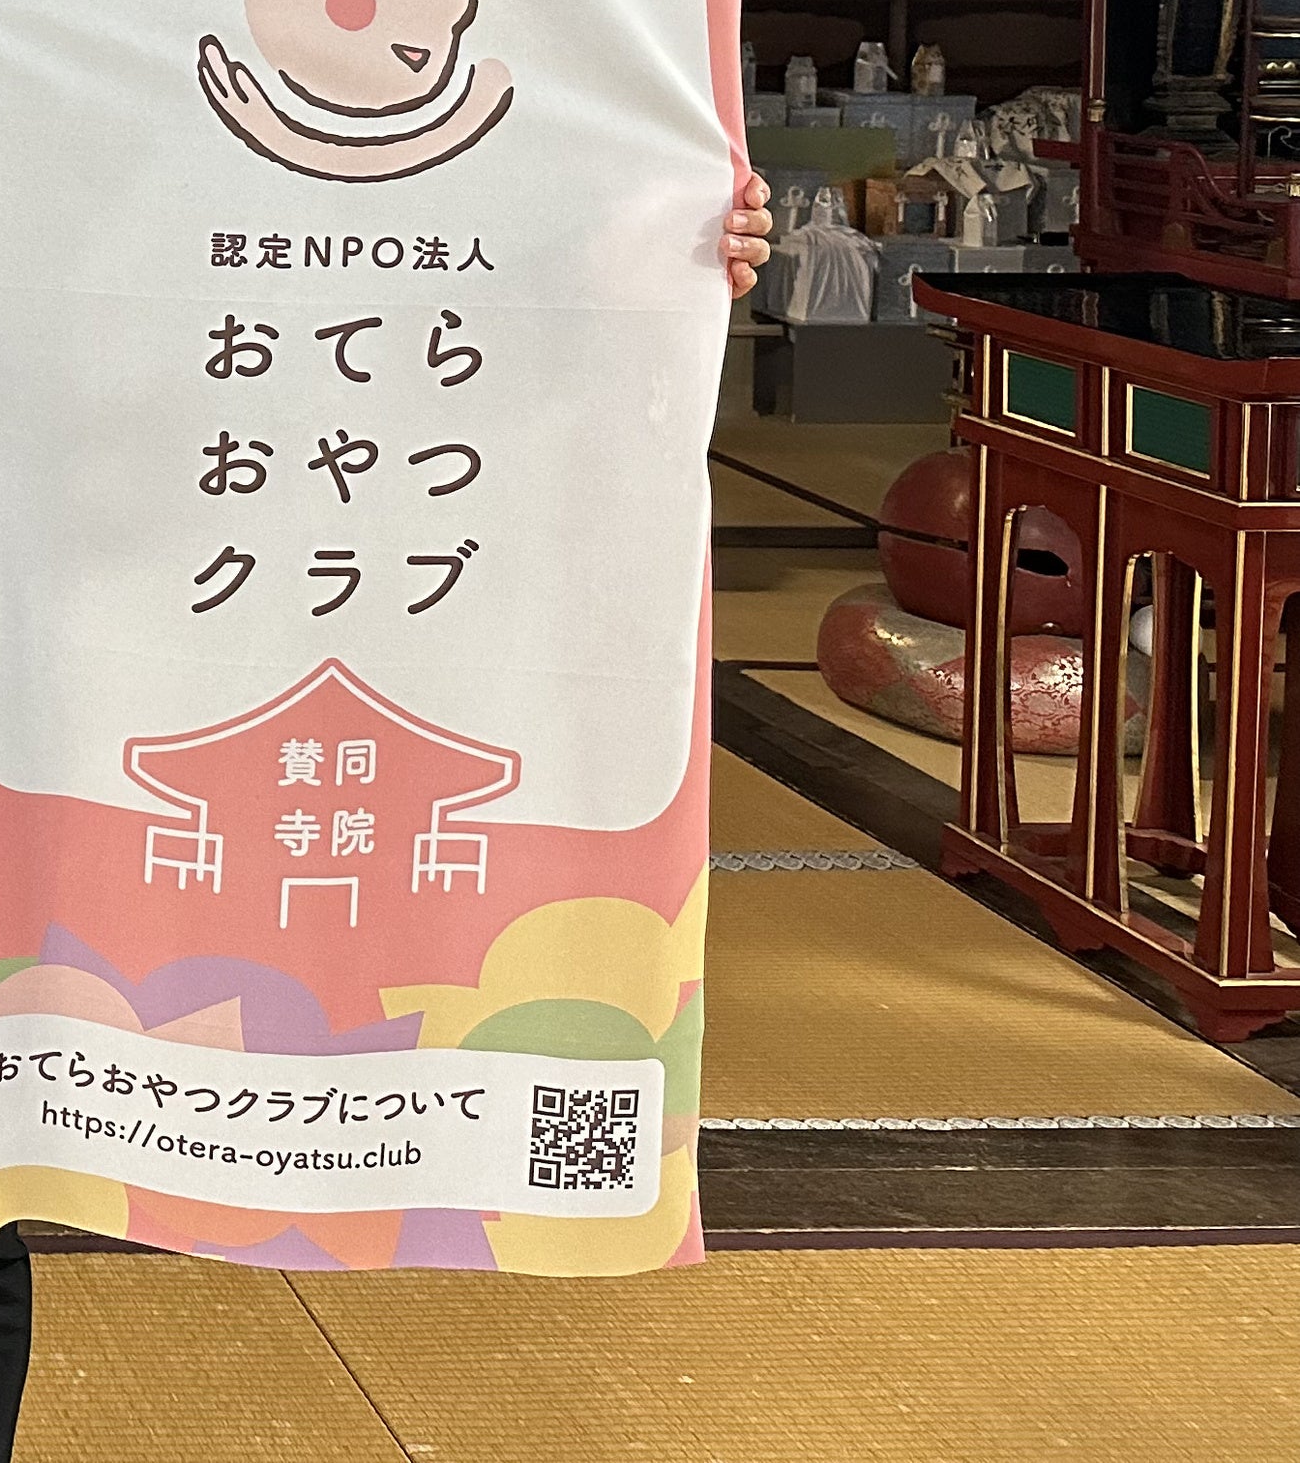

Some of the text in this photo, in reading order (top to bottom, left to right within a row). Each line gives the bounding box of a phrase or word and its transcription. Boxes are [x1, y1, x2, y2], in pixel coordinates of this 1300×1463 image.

[210, 232, 495, 272] 認定NPO法人
[205, 309, 483, 387] おてら
[199, 429, 482, 504] おやつ
[191, 538, 480, 617] クラブ
[277, 738, 378, 787] 賛同
[273, 808, 377, 858] 寺院
[41, 1100, 422, 1176] https://otera-oyatsu.club
